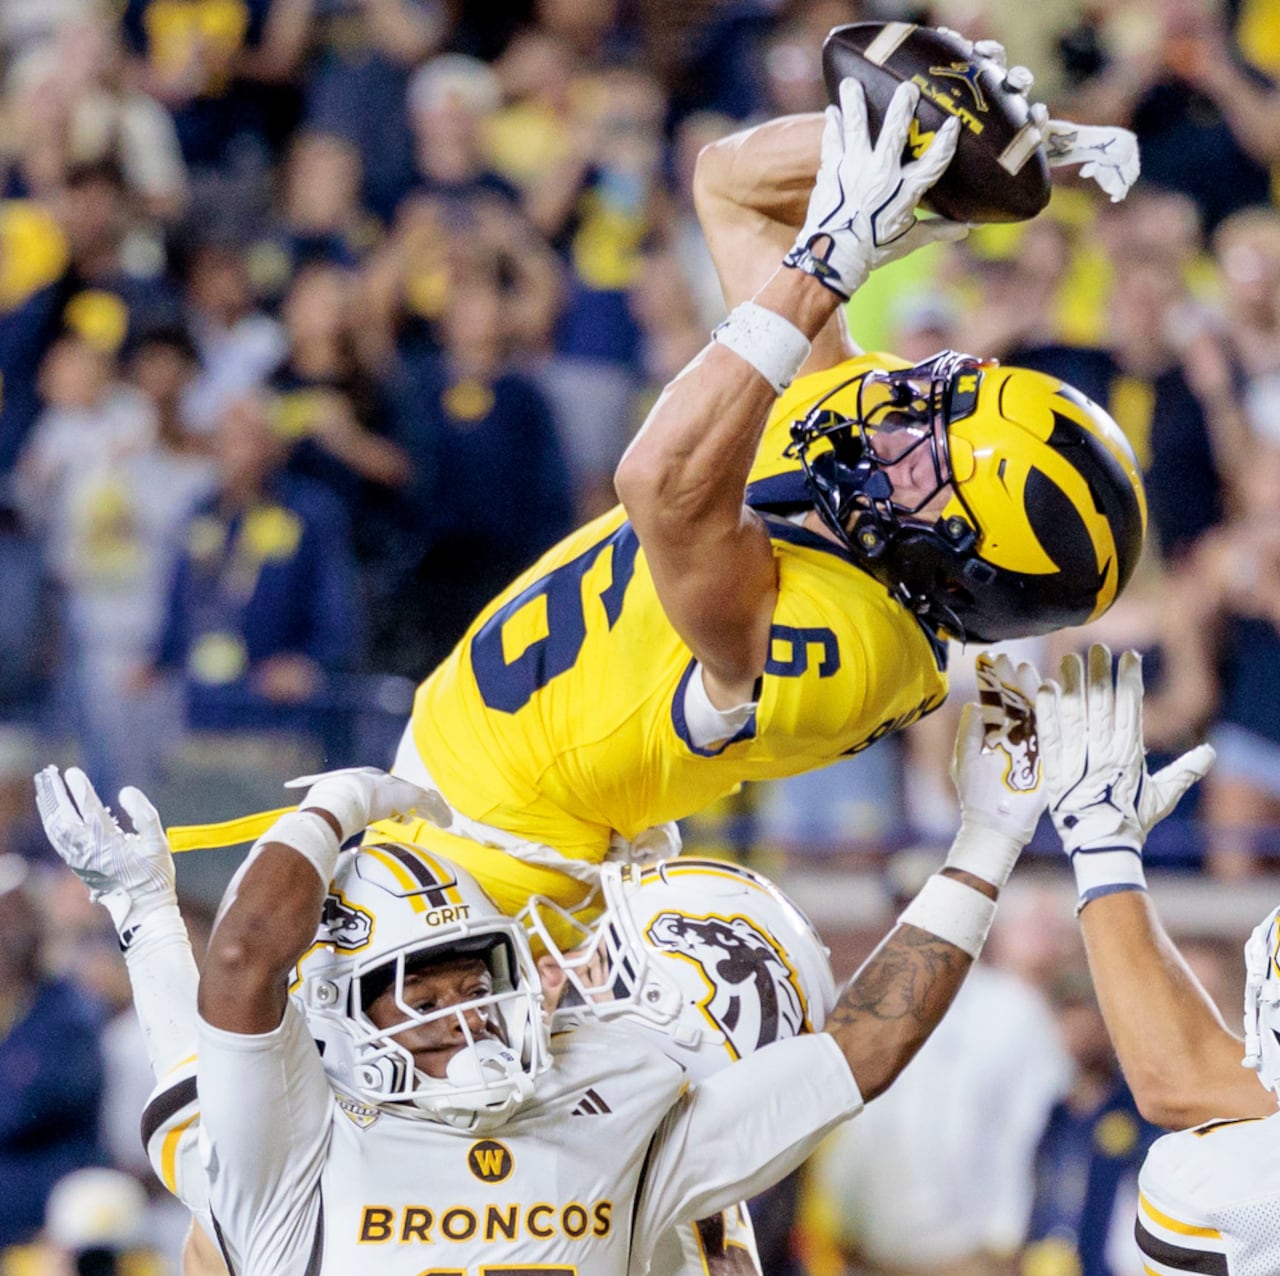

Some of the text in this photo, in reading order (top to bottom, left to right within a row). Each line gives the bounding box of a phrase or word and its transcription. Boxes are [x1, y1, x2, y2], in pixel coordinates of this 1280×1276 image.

[470, 518, 642, 716] 6
[763, 623, 842, 679] 6
[425, 904, 472, 928] GRIT
[473, 1148, 504, 1177] W
[357, 1200, 613, 1245] BRONCOS
